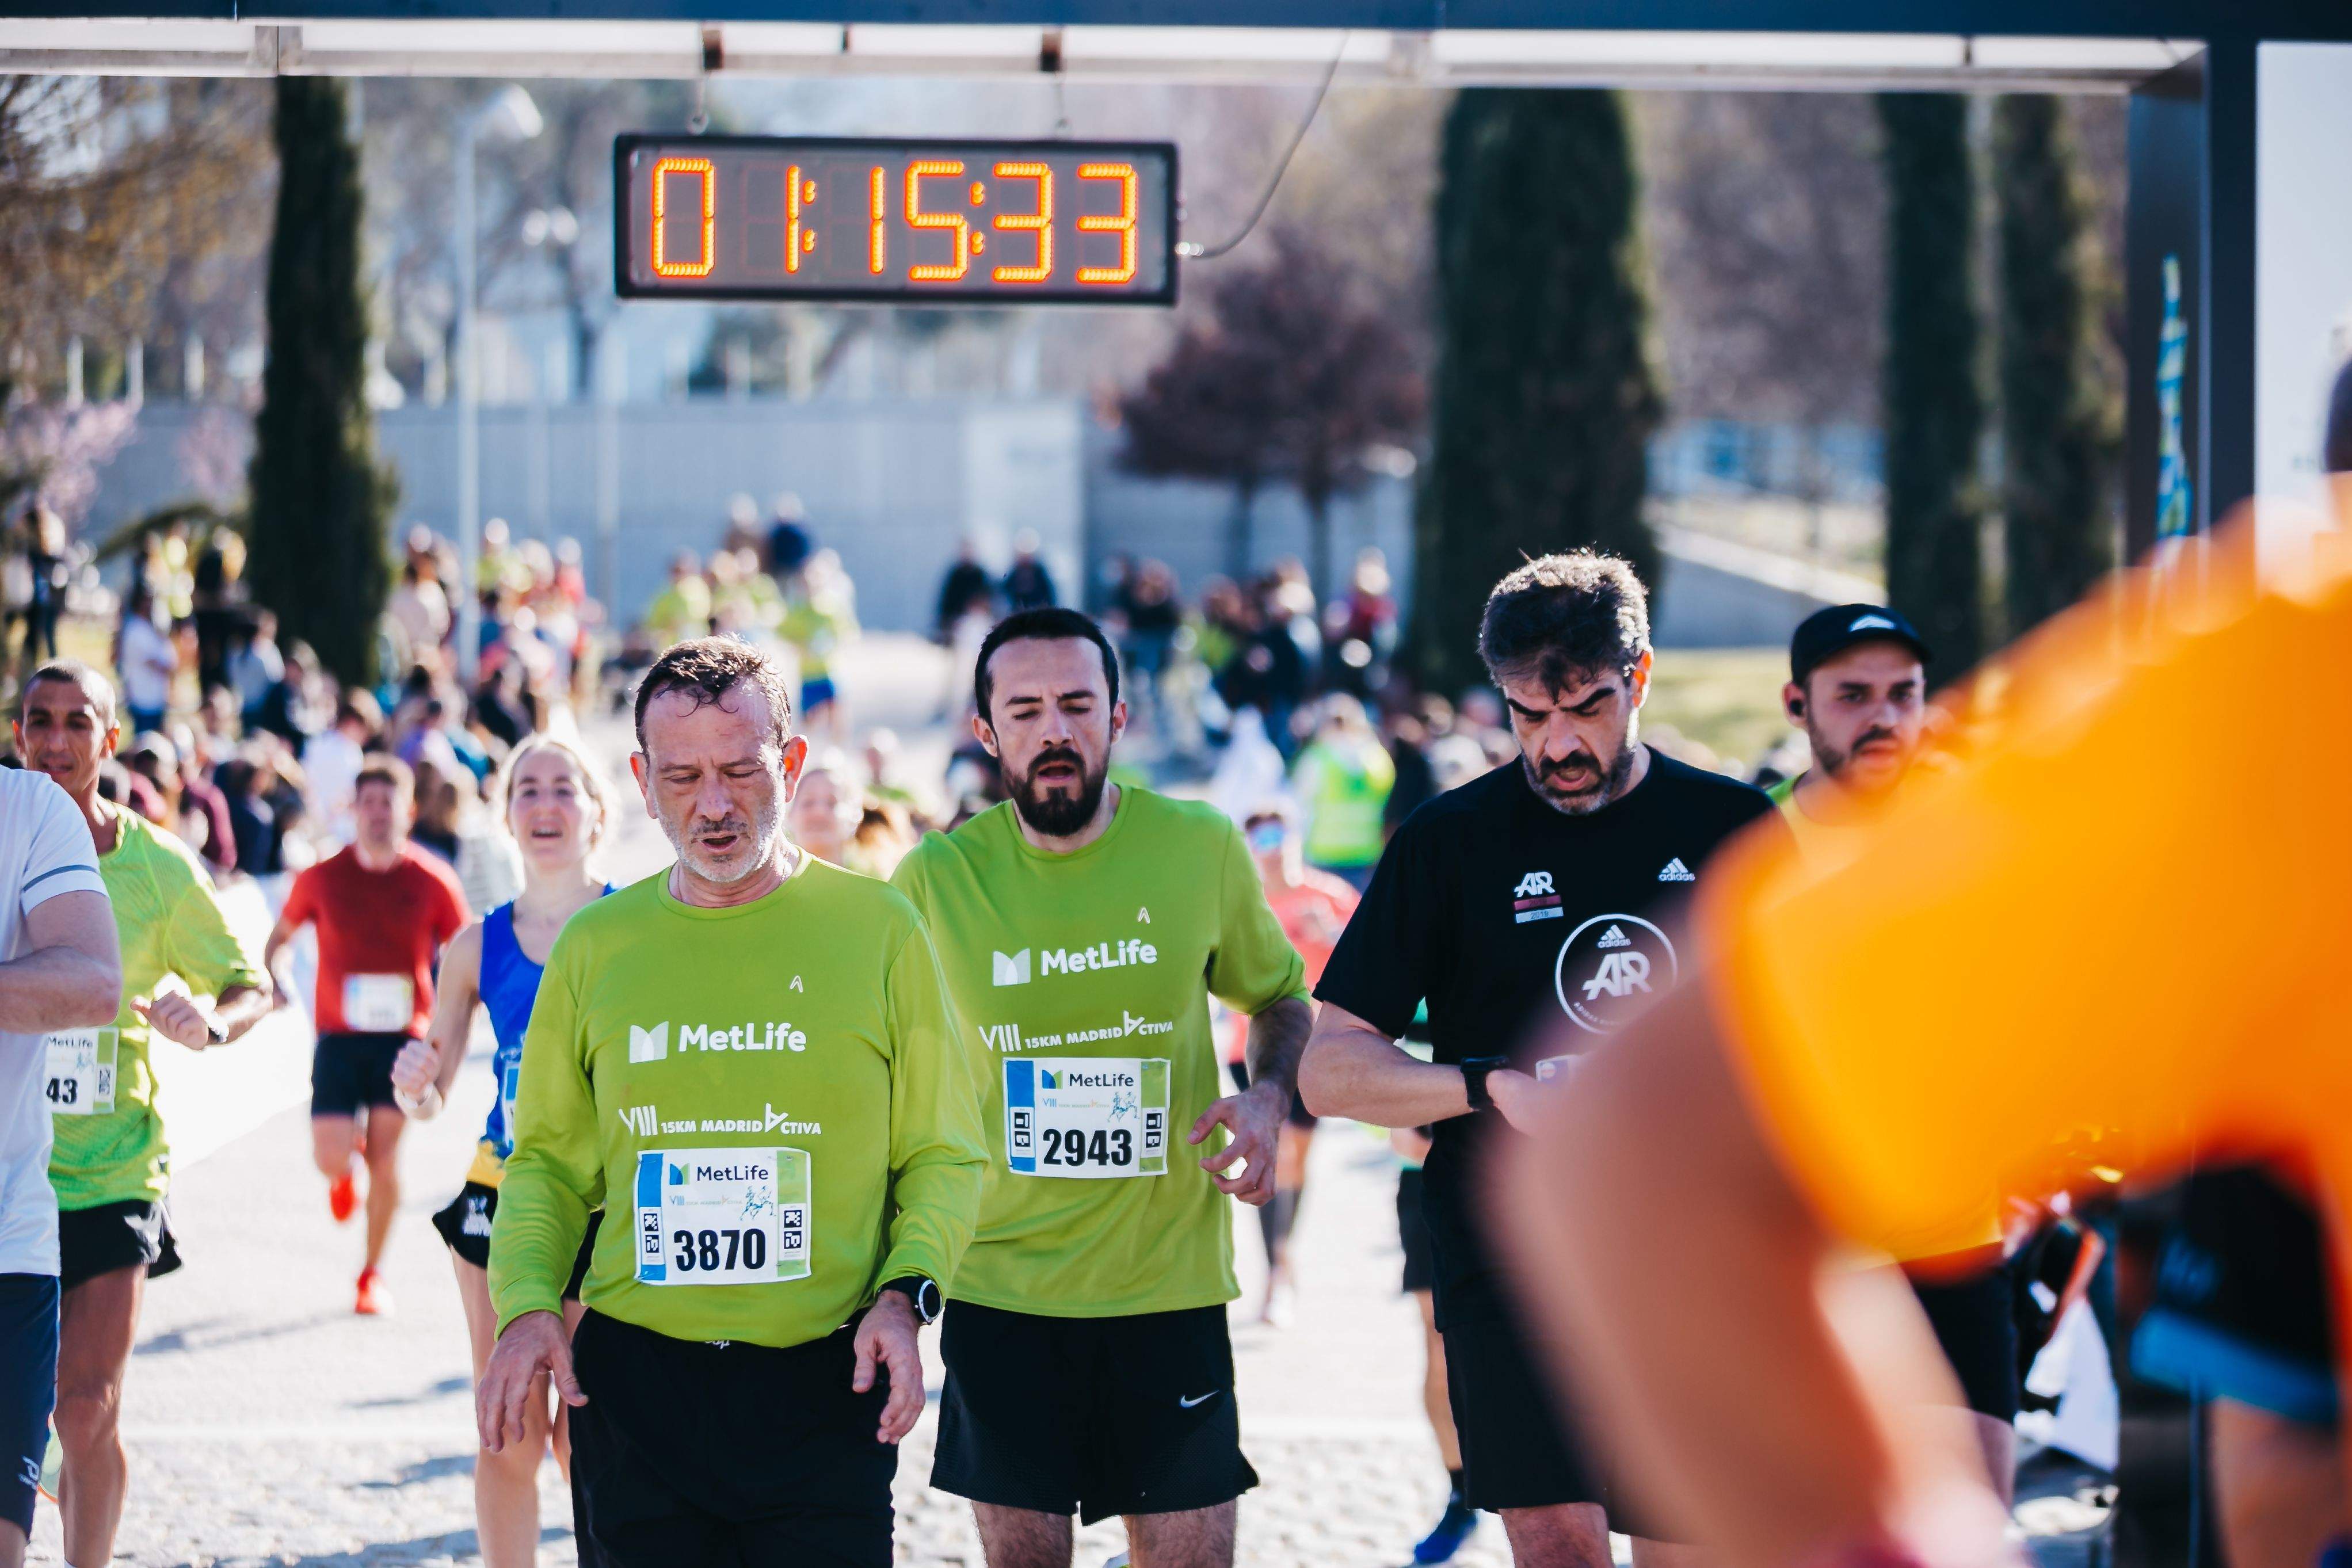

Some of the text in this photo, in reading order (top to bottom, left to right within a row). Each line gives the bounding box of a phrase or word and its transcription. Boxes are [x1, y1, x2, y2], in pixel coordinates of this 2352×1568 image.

[651, 157, 1138, 283] 01:15:33
[1514, 871, 1555, 898] AR
[1659, 872, 1695, 881] adidas
[1040, 938, 1157, 976] MetLife
[1598, 938, 1631, 948] adidas
[1582, 951, 1653, 1001] AR
[47, 1036, 93, 1048] MetLife
[678, 1022, 807, 1052] MetLife
[978, 1024, 1021, 1052] VIII
[1024, 1035, 1062, 1049] 15KM
[1066, 1027, 1122, 1044] MADRID
[1069, 1074, 1134, 1087] MetLife
[619, 1105, 658, 1136] VIII
[661, 1120, 697, 1134] 15KM
[700, 1120, 763, 1132] MADRID
[1043, 1128, 1133, 1167] 2943
[697, 1165, 769, 1181] MetLife
[673, 1229, 766, 1272] 3870
